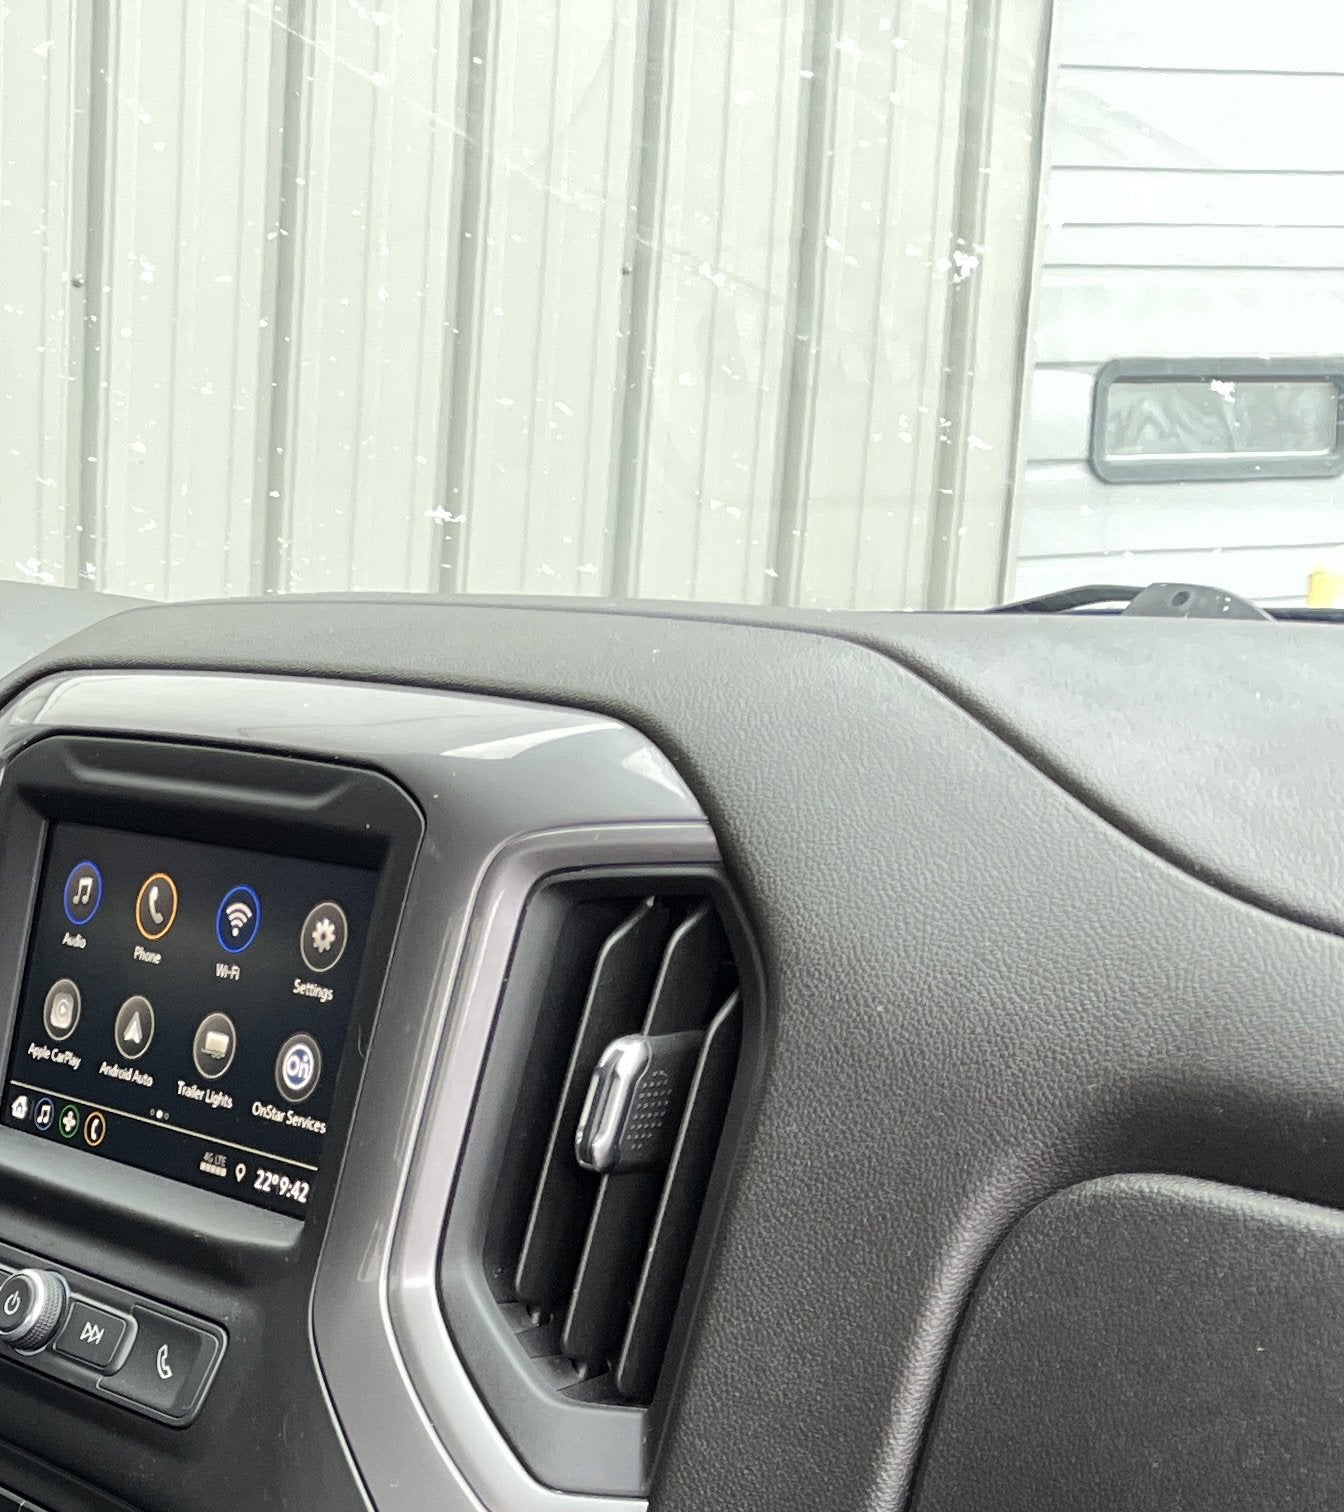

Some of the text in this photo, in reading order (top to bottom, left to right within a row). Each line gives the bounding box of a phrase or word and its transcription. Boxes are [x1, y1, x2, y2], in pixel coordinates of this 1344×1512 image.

[62, 931, 87, 949] Audio
[133, 945, 162, 965] Phone
[215, 962, 241, 981] Wi-Fi
[292, 978, 334, 1003] Settings
[27, 1042, 82, 1070] Apple CarPlay
[99, 1060, 154, 1088] Android Auto
[177, 1079, 234, 1110] Trailer Lights
[251, 1101, 327, 1135] OnStar Services
[214, 1154, 228, 1168] LTE
[279, 1175, 311, 1204] 9:42
